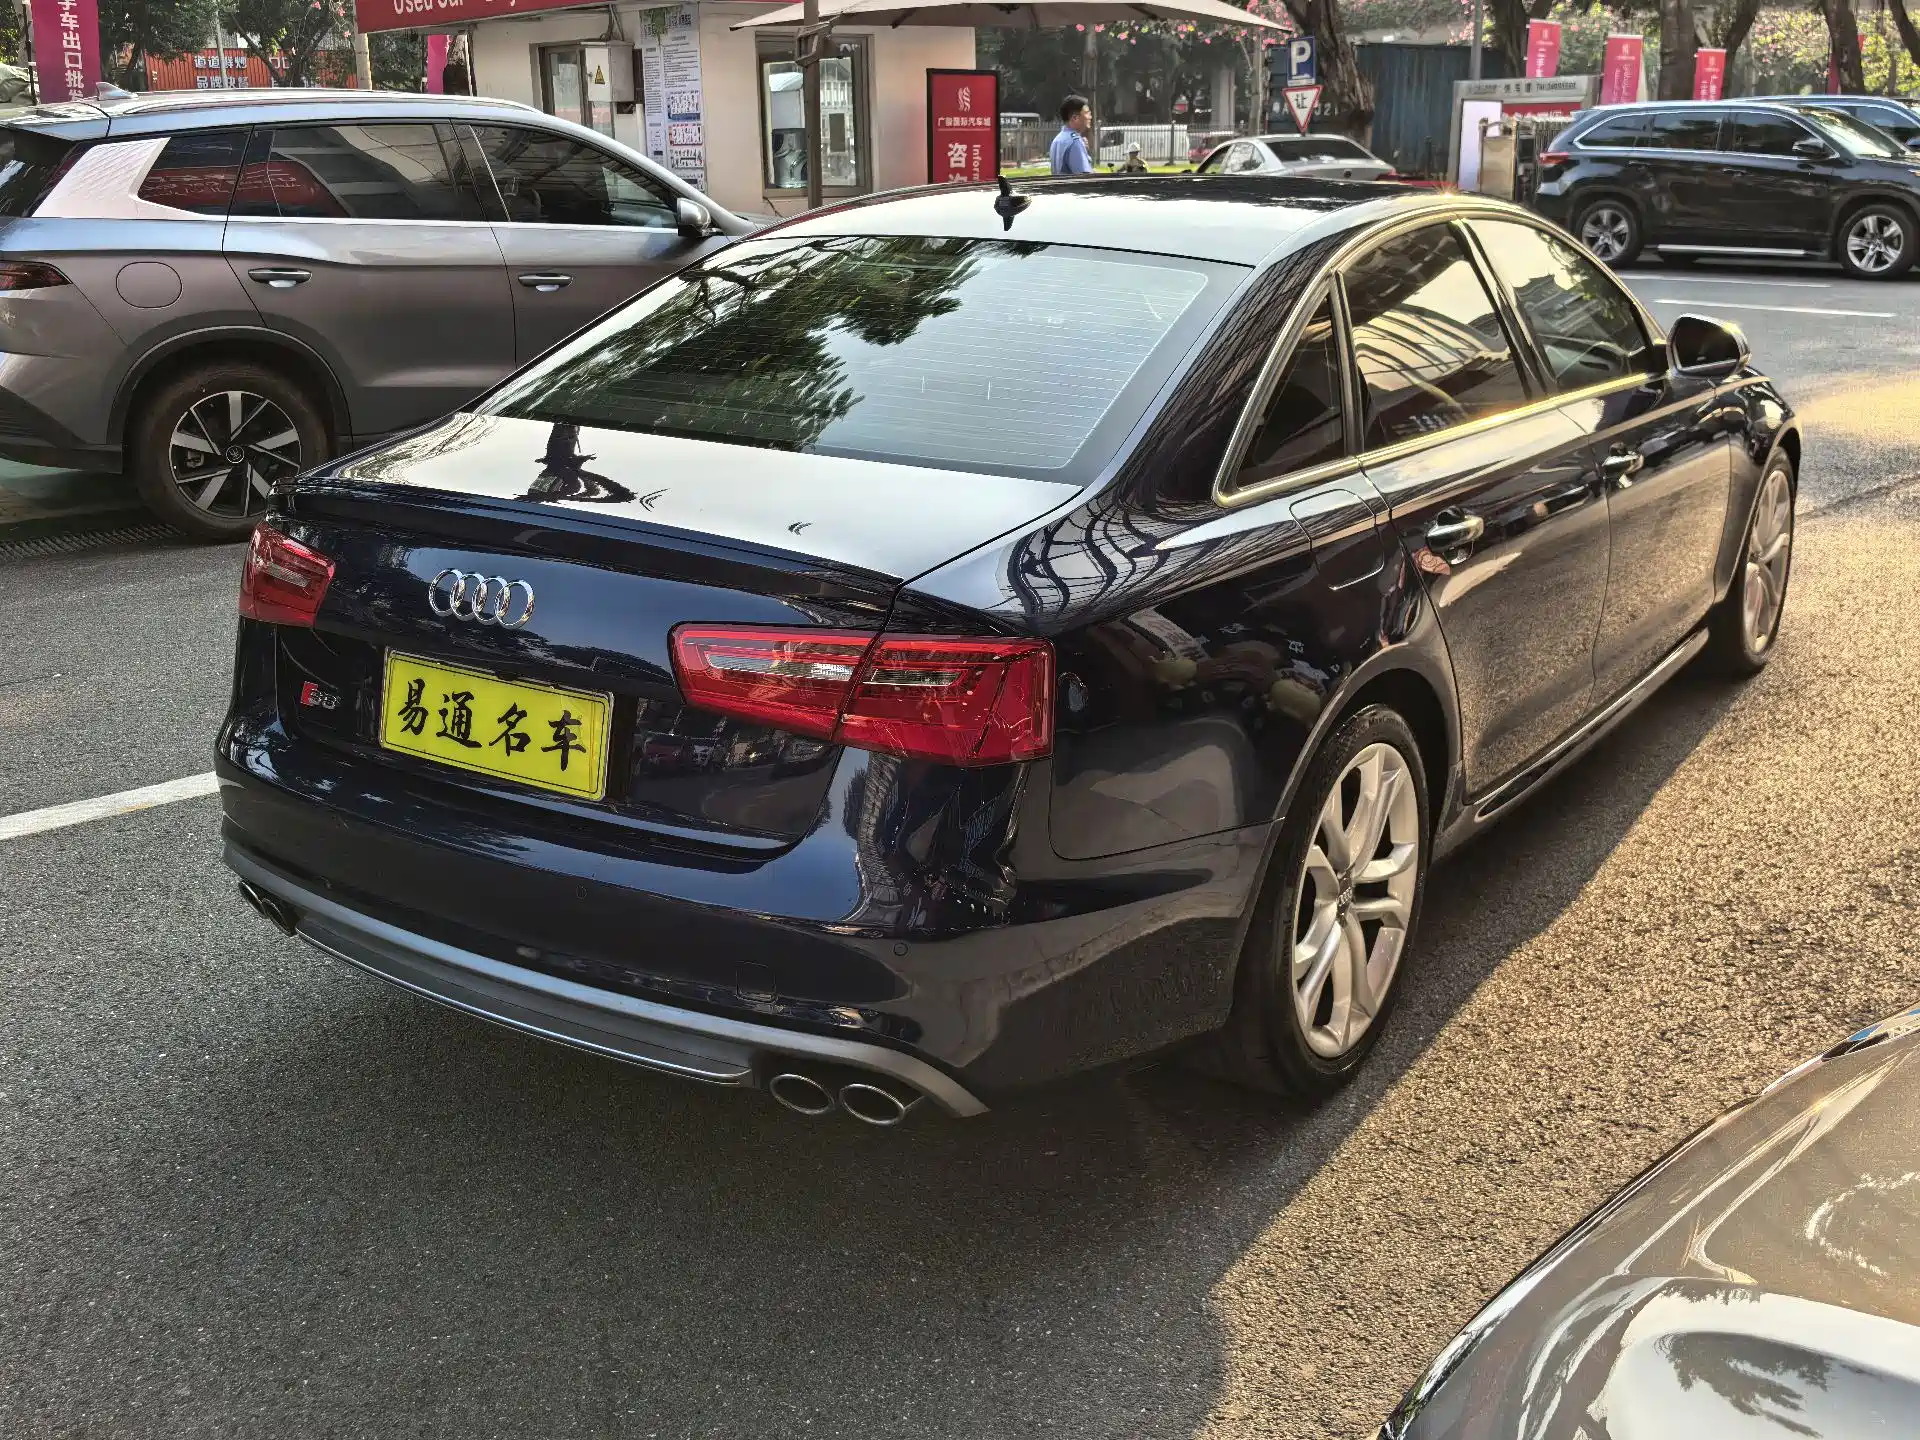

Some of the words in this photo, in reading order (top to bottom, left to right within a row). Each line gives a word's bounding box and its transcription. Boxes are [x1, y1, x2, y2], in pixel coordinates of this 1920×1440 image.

[1291, 41, 1311, 76] P
[398, 679, 586, 771] 易通名车
